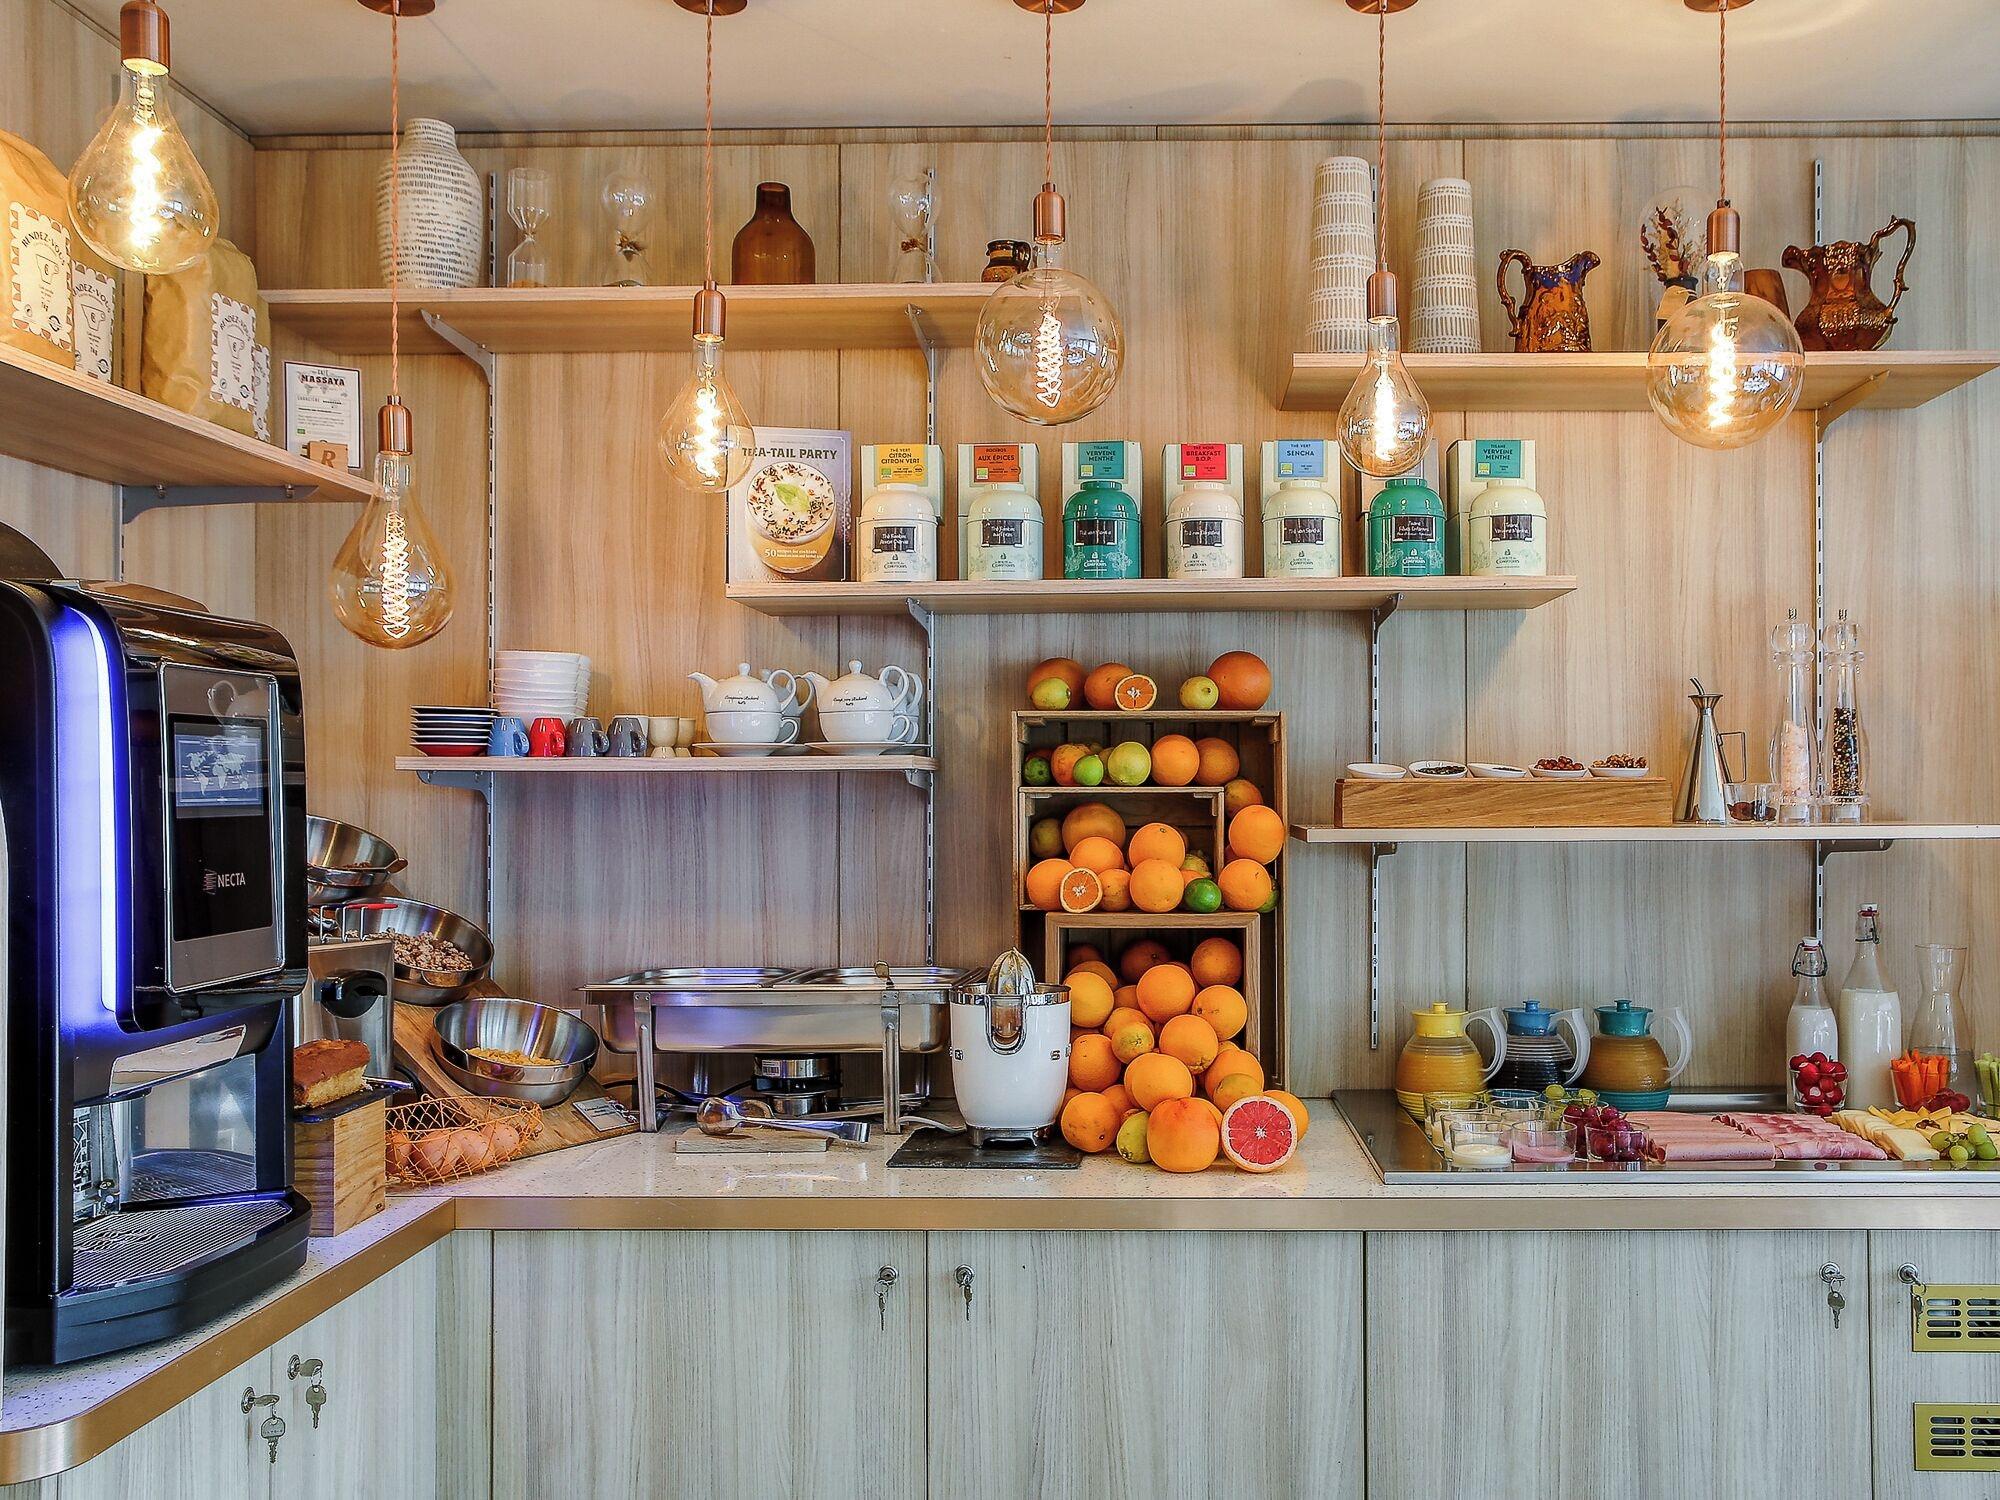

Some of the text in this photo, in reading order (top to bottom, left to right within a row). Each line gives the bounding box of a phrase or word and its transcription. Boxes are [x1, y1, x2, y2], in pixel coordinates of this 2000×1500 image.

[22, 231, 65, 266] RENDEZ-VOUS
[73, 284, 111, 313] ENDEZ-VOUS
[322, 450, 336, 468] R
[800, 448, 837, 460] PARTY
[764, 548, 777, 557] 50
[217, 872, 246, 888] NECTA
